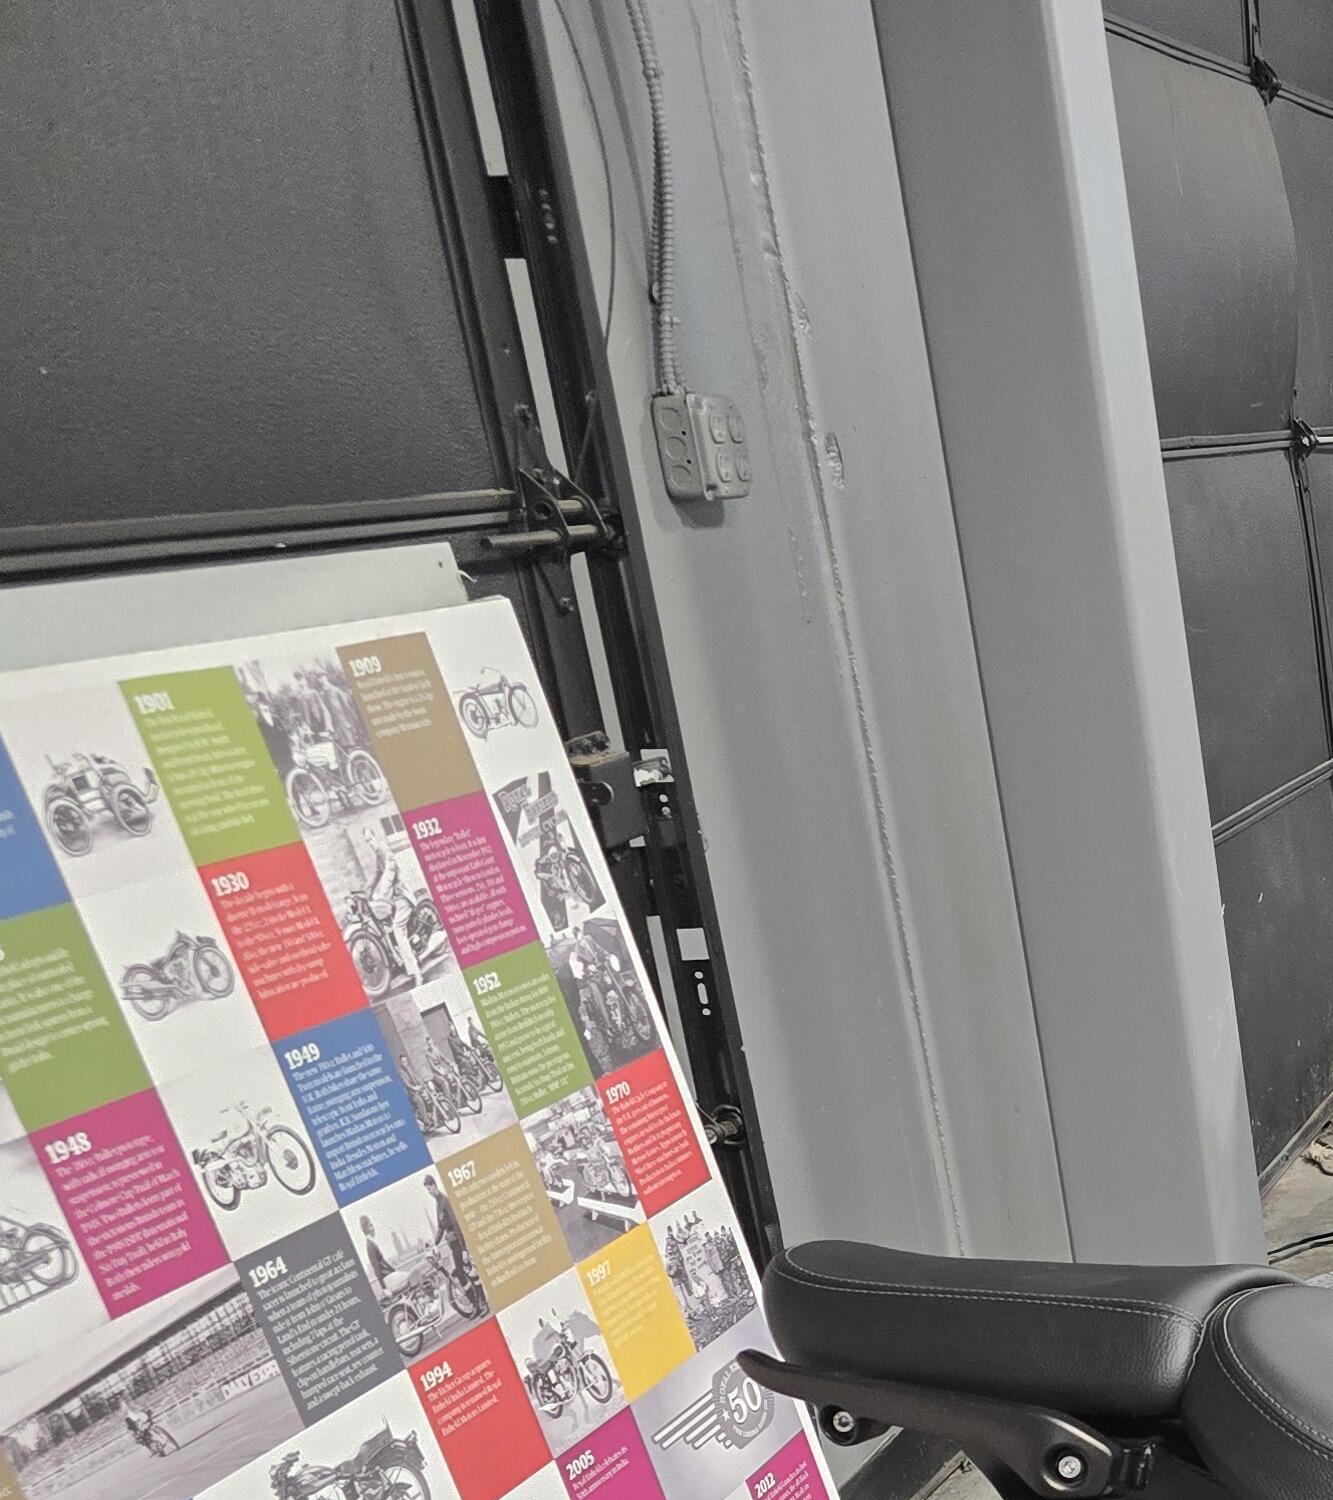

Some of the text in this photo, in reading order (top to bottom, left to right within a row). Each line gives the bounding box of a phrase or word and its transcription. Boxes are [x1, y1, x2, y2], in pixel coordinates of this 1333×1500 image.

[349, 655, 382, 677] 1909
[412, 818, 442, 840] 1932
[211, 871, 249, 897] 1930
[473, 972, 501, 995] 1952
[284, 1043, 320, 1070] 1949
[605, 1081, 630, 1104] 1970
[44, 1132, 92, 1164] 1948
[448, 1160, 476, 1187] 1967
[249, 1256, 288, 1288] 1964
[586, 1260, 612, 1287] 1997
[420, 1361, 453, 1392] 1994
[727, 1376, 762, 1424] 50
[566, 1450, 595, 1480] 2005
[754, 1472, 776, 1498] 2012
